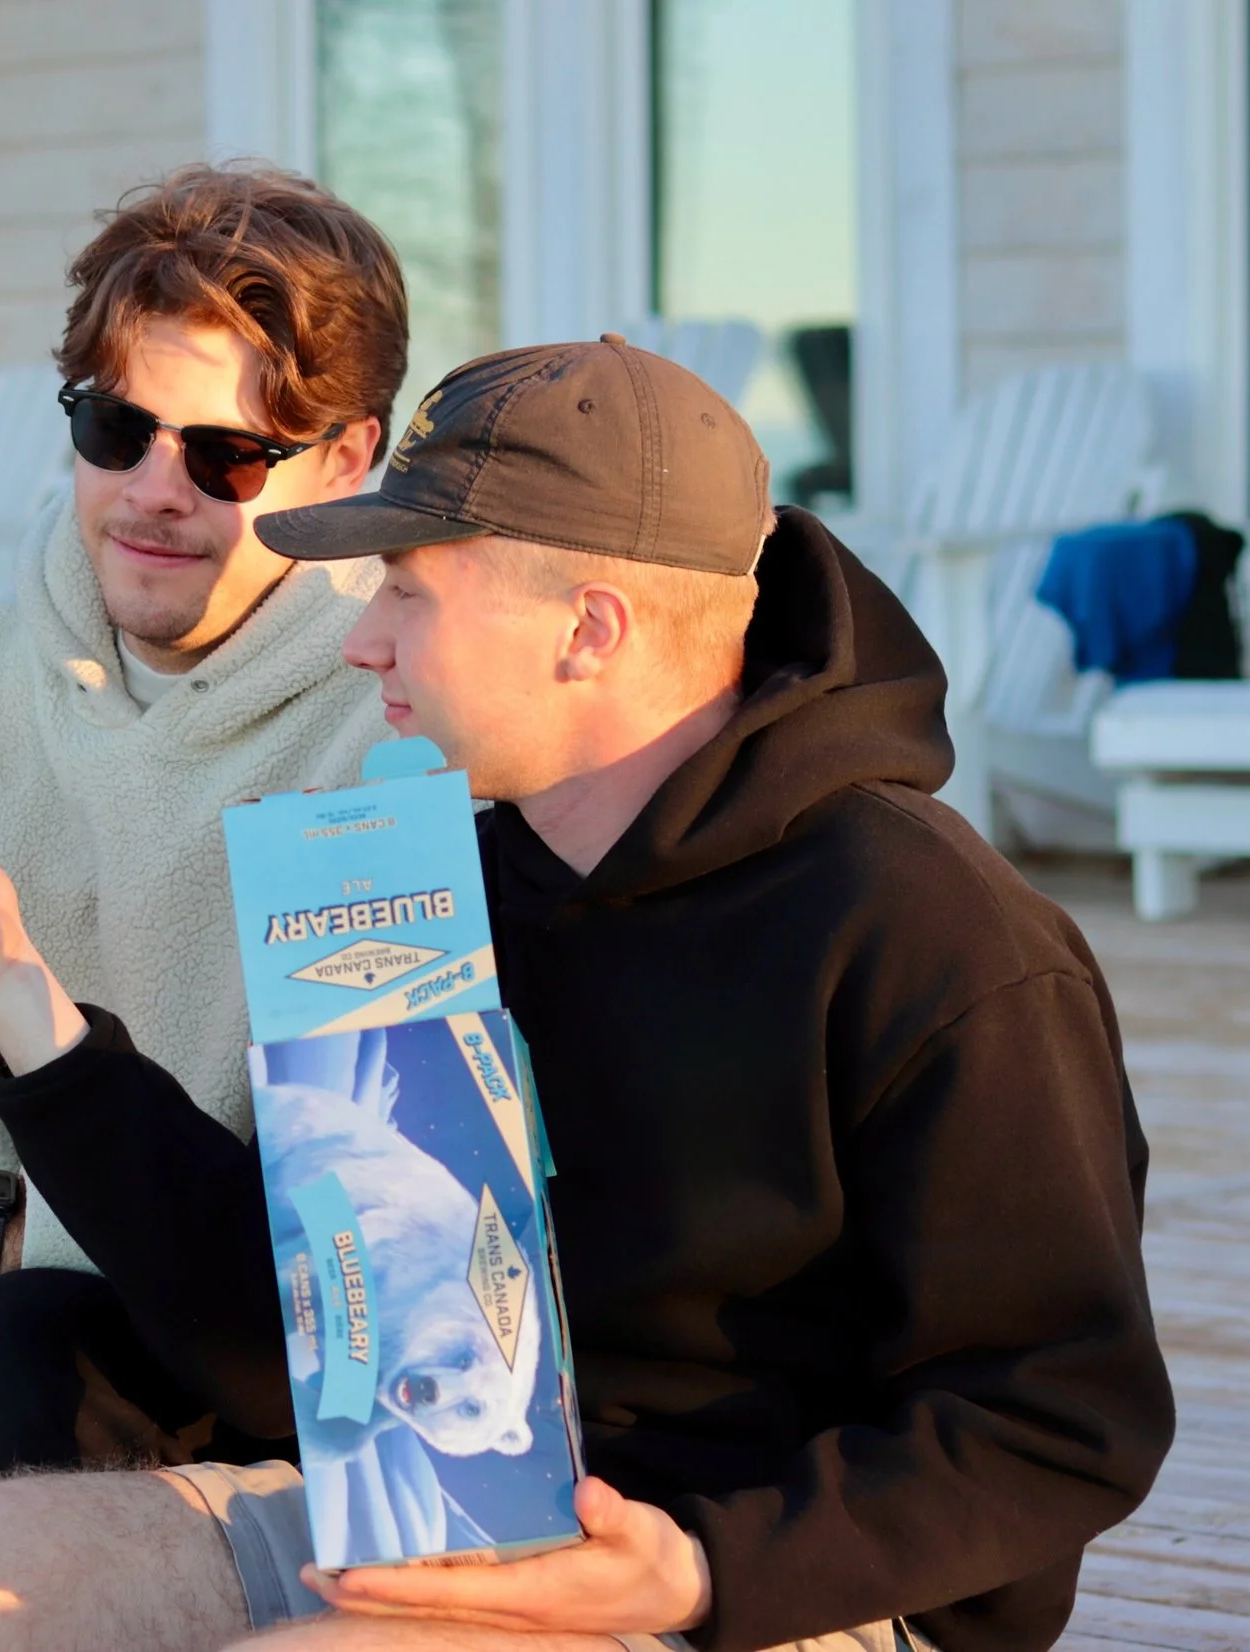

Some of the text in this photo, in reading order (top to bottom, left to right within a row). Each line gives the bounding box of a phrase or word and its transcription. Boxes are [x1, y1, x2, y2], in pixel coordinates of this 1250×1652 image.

[354, 818, 385, 832] CANS
[341, 877, 372, 896] ALE
[264, 888, 455, 945] BLUEBEARY
[315, 951, 421, 978] TRANS CANADA
[354, 947, 391, 959] BREWING
[478, 1247, 492, 1292] BREWING
[483, 1211, 512, 1339] TRANS CANADA
[333, 1230, 370, 1366] BLUEBEARY
